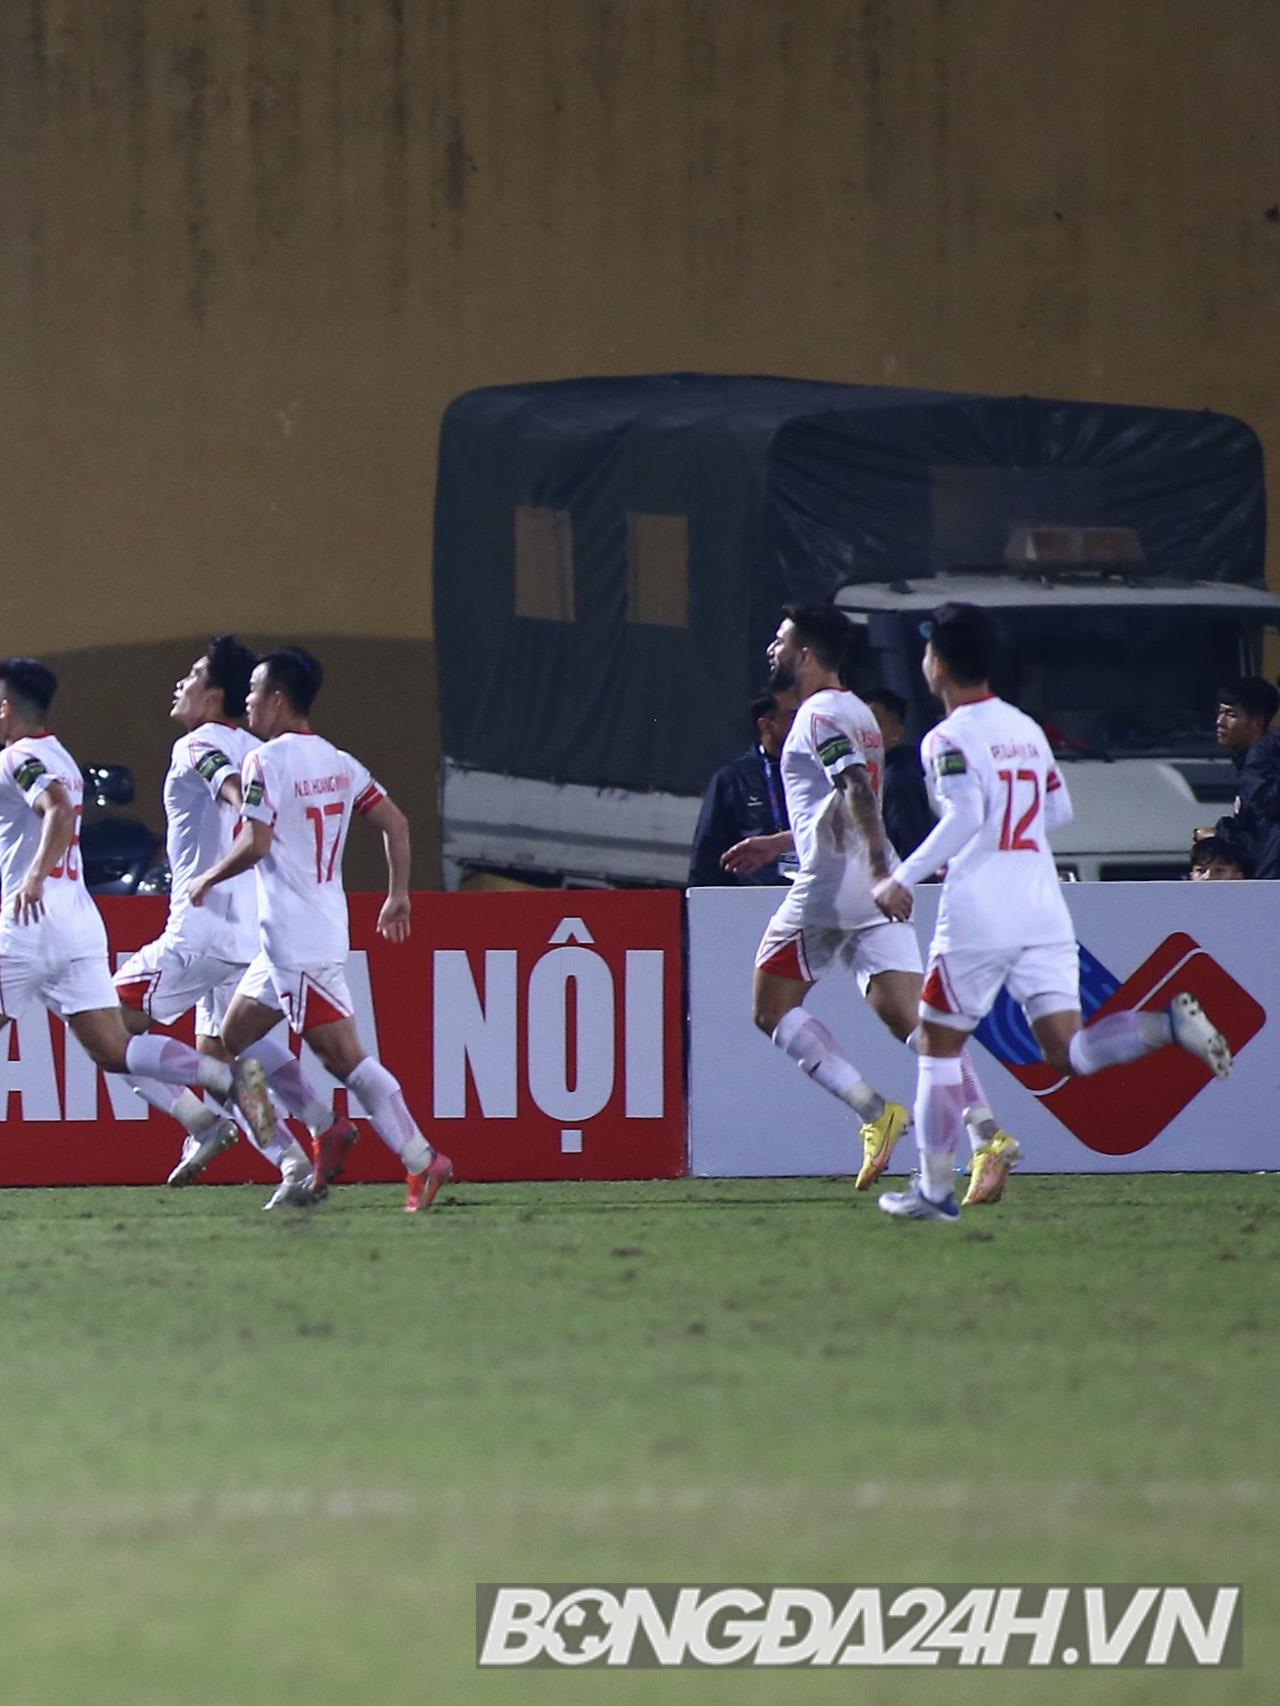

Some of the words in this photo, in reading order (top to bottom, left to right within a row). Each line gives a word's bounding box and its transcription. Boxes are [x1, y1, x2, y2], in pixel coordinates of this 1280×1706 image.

[305, 801, 345, 884] 17
[997, 768, 1040, 852] 12
[433, 917, 664, 1153] NỘI
